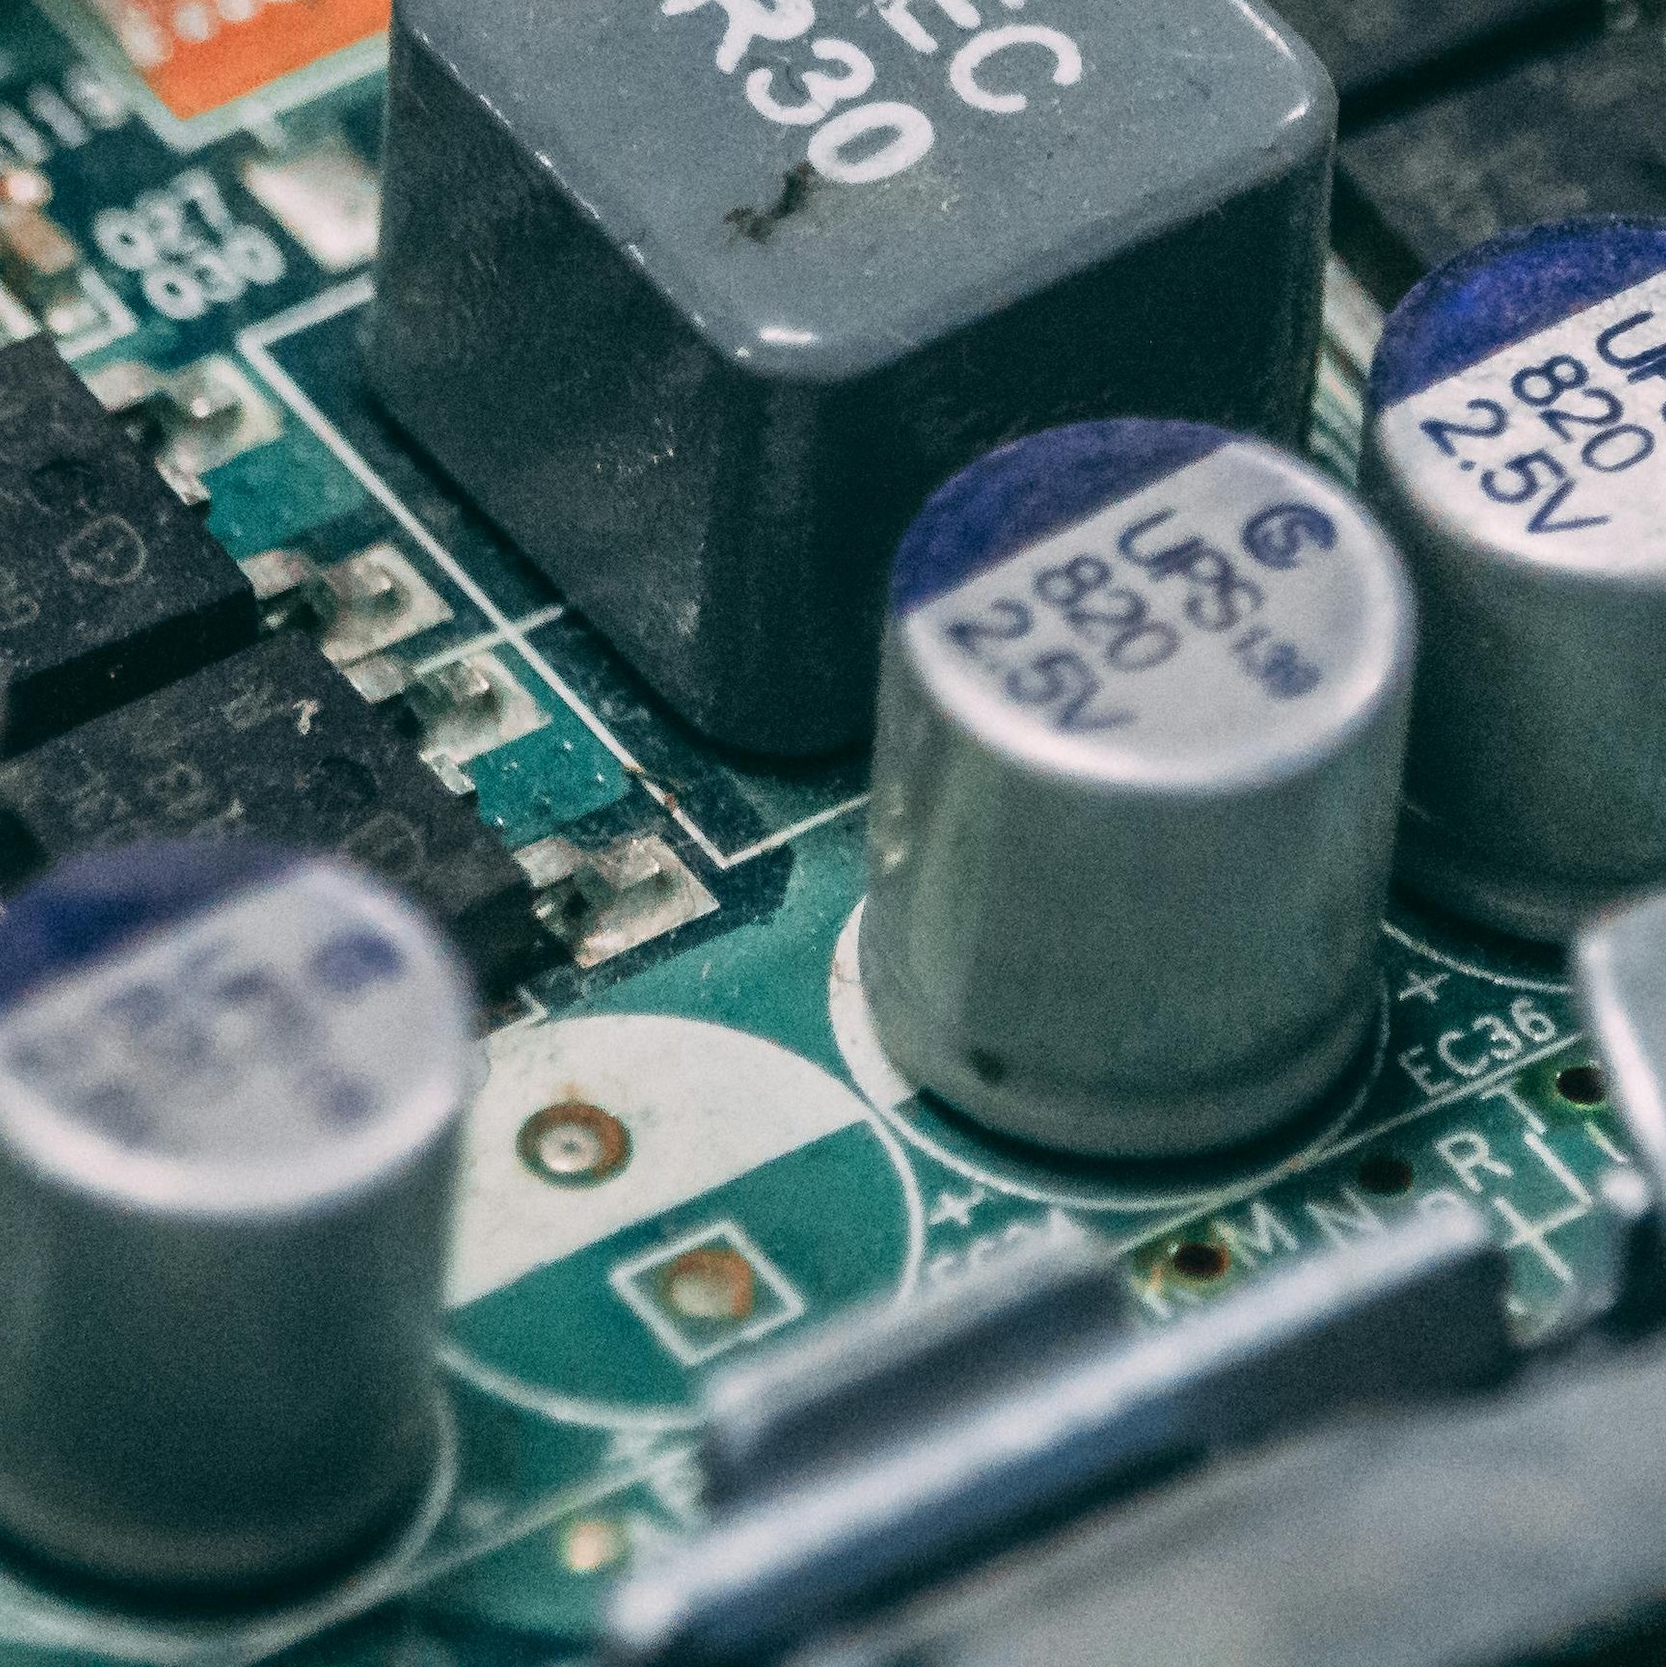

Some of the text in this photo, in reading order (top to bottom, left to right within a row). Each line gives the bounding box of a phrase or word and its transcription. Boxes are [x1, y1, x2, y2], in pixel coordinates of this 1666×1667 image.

[1417, 396, 1613, 534] 2.5V
[1509, 353, 1656, 474] 820
[1035, 552, 1181, 674] 820
[1115, 507, 1266, 634] UPS
[1399, 997, 1557, 1095] EC36
[1435, 1130, 1515, 1193] R
